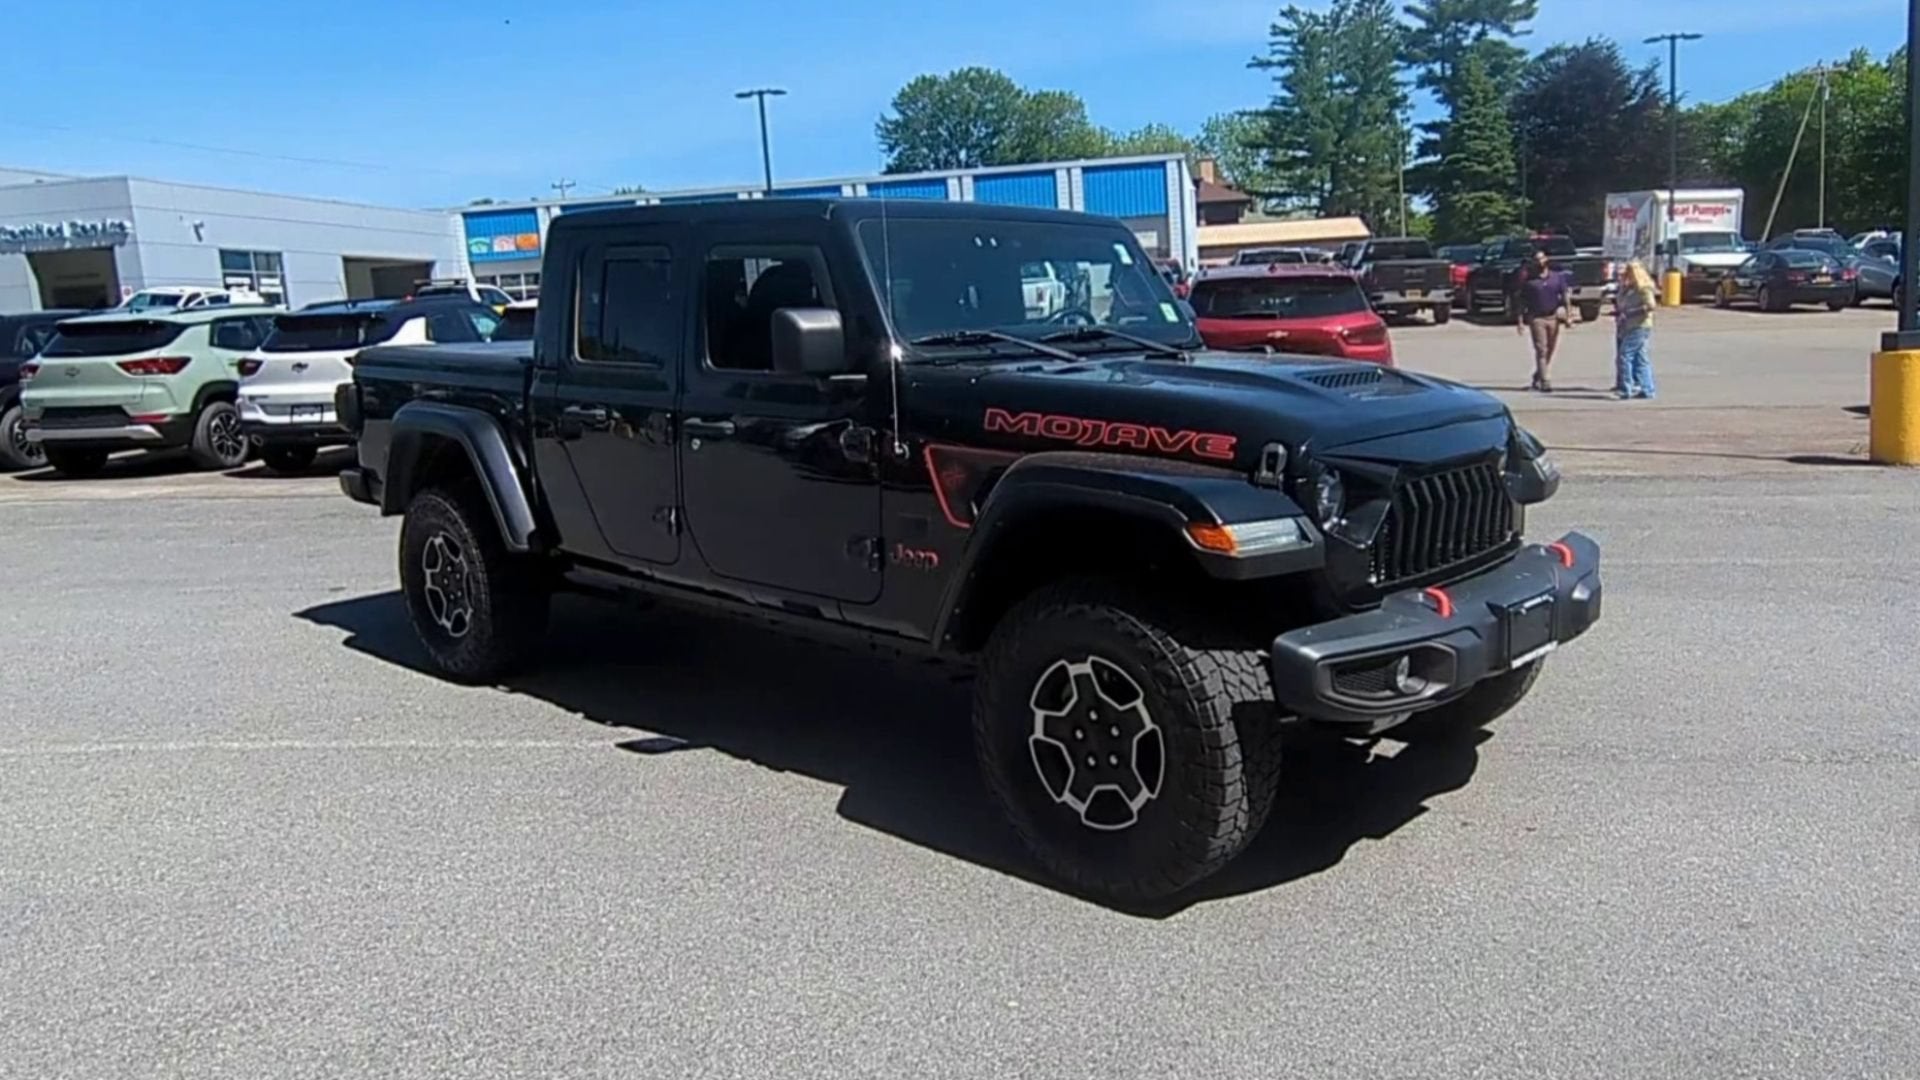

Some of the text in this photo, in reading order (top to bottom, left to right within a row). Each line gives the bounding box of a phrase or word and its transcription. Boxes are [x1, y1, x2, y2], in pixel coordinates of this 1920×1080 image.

[1692, 203, 1725, 217] Pumps
[984, 408, 1237, 460] MOJAVE
[890, 542, 940, 573] Jeep
